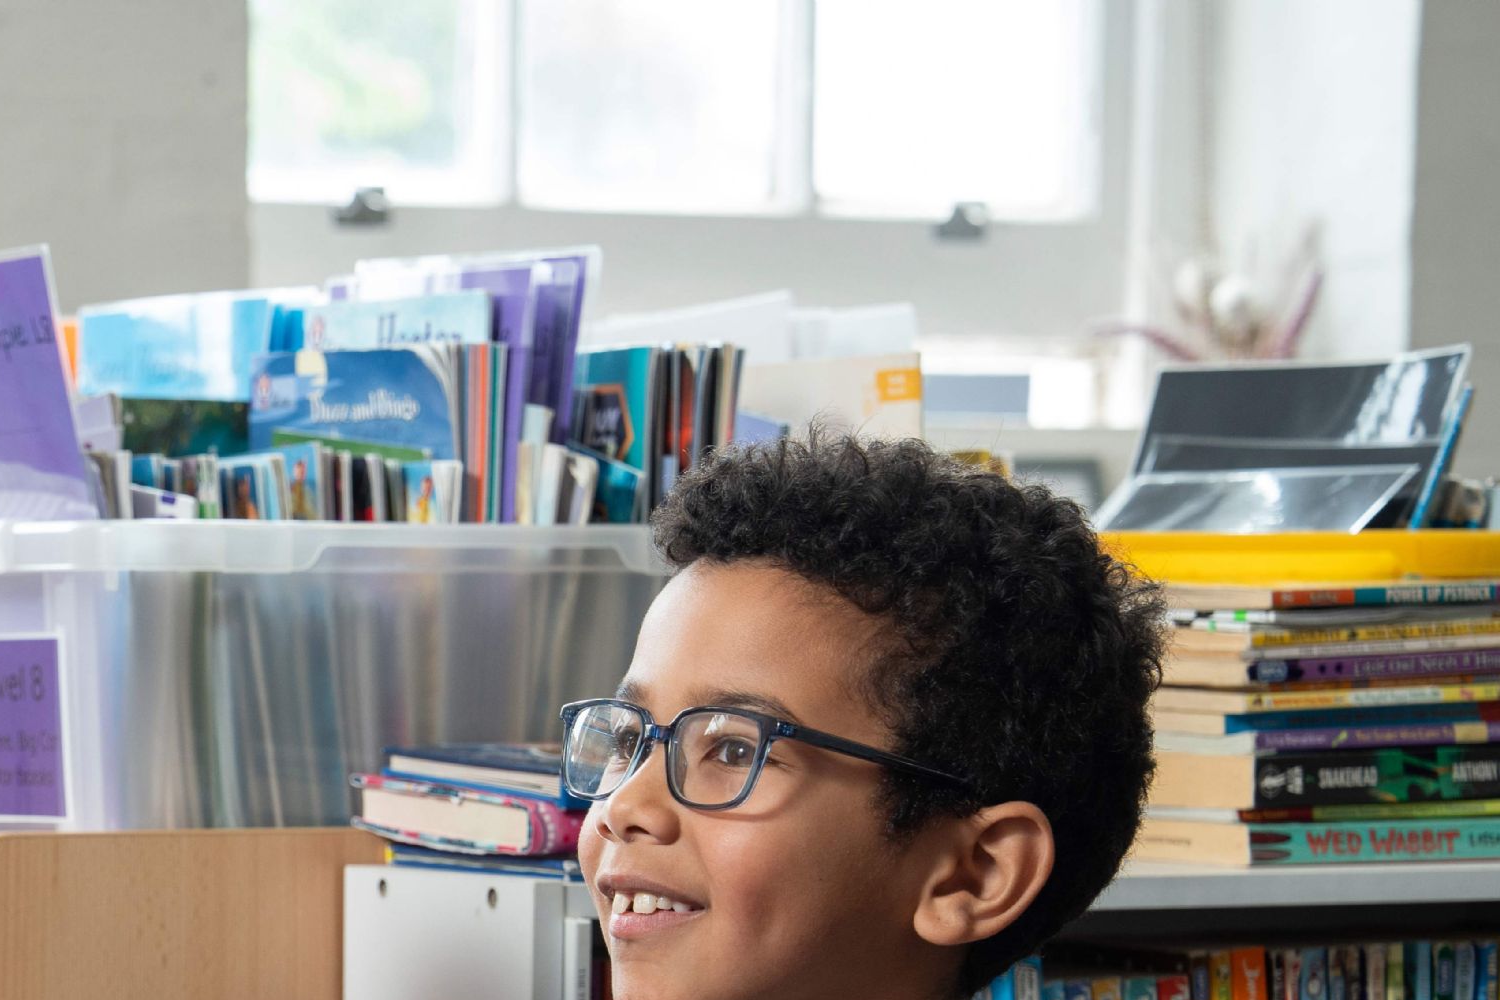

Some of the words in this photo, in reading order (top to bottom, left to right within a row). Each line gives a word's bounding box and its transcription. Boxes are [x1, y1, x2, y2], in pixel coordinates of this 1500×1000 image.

[1385, 587, 1423, 602] POWER
[1426, 587, 1443, 601] UP
[1318, 765, 1378, 789] SNAKEHEAD
[1451, 760, 1498, 782] ANTHONY
[1306, 829, 1361, 857] WED
[1369, 827, 1461, 856] WABBIT
